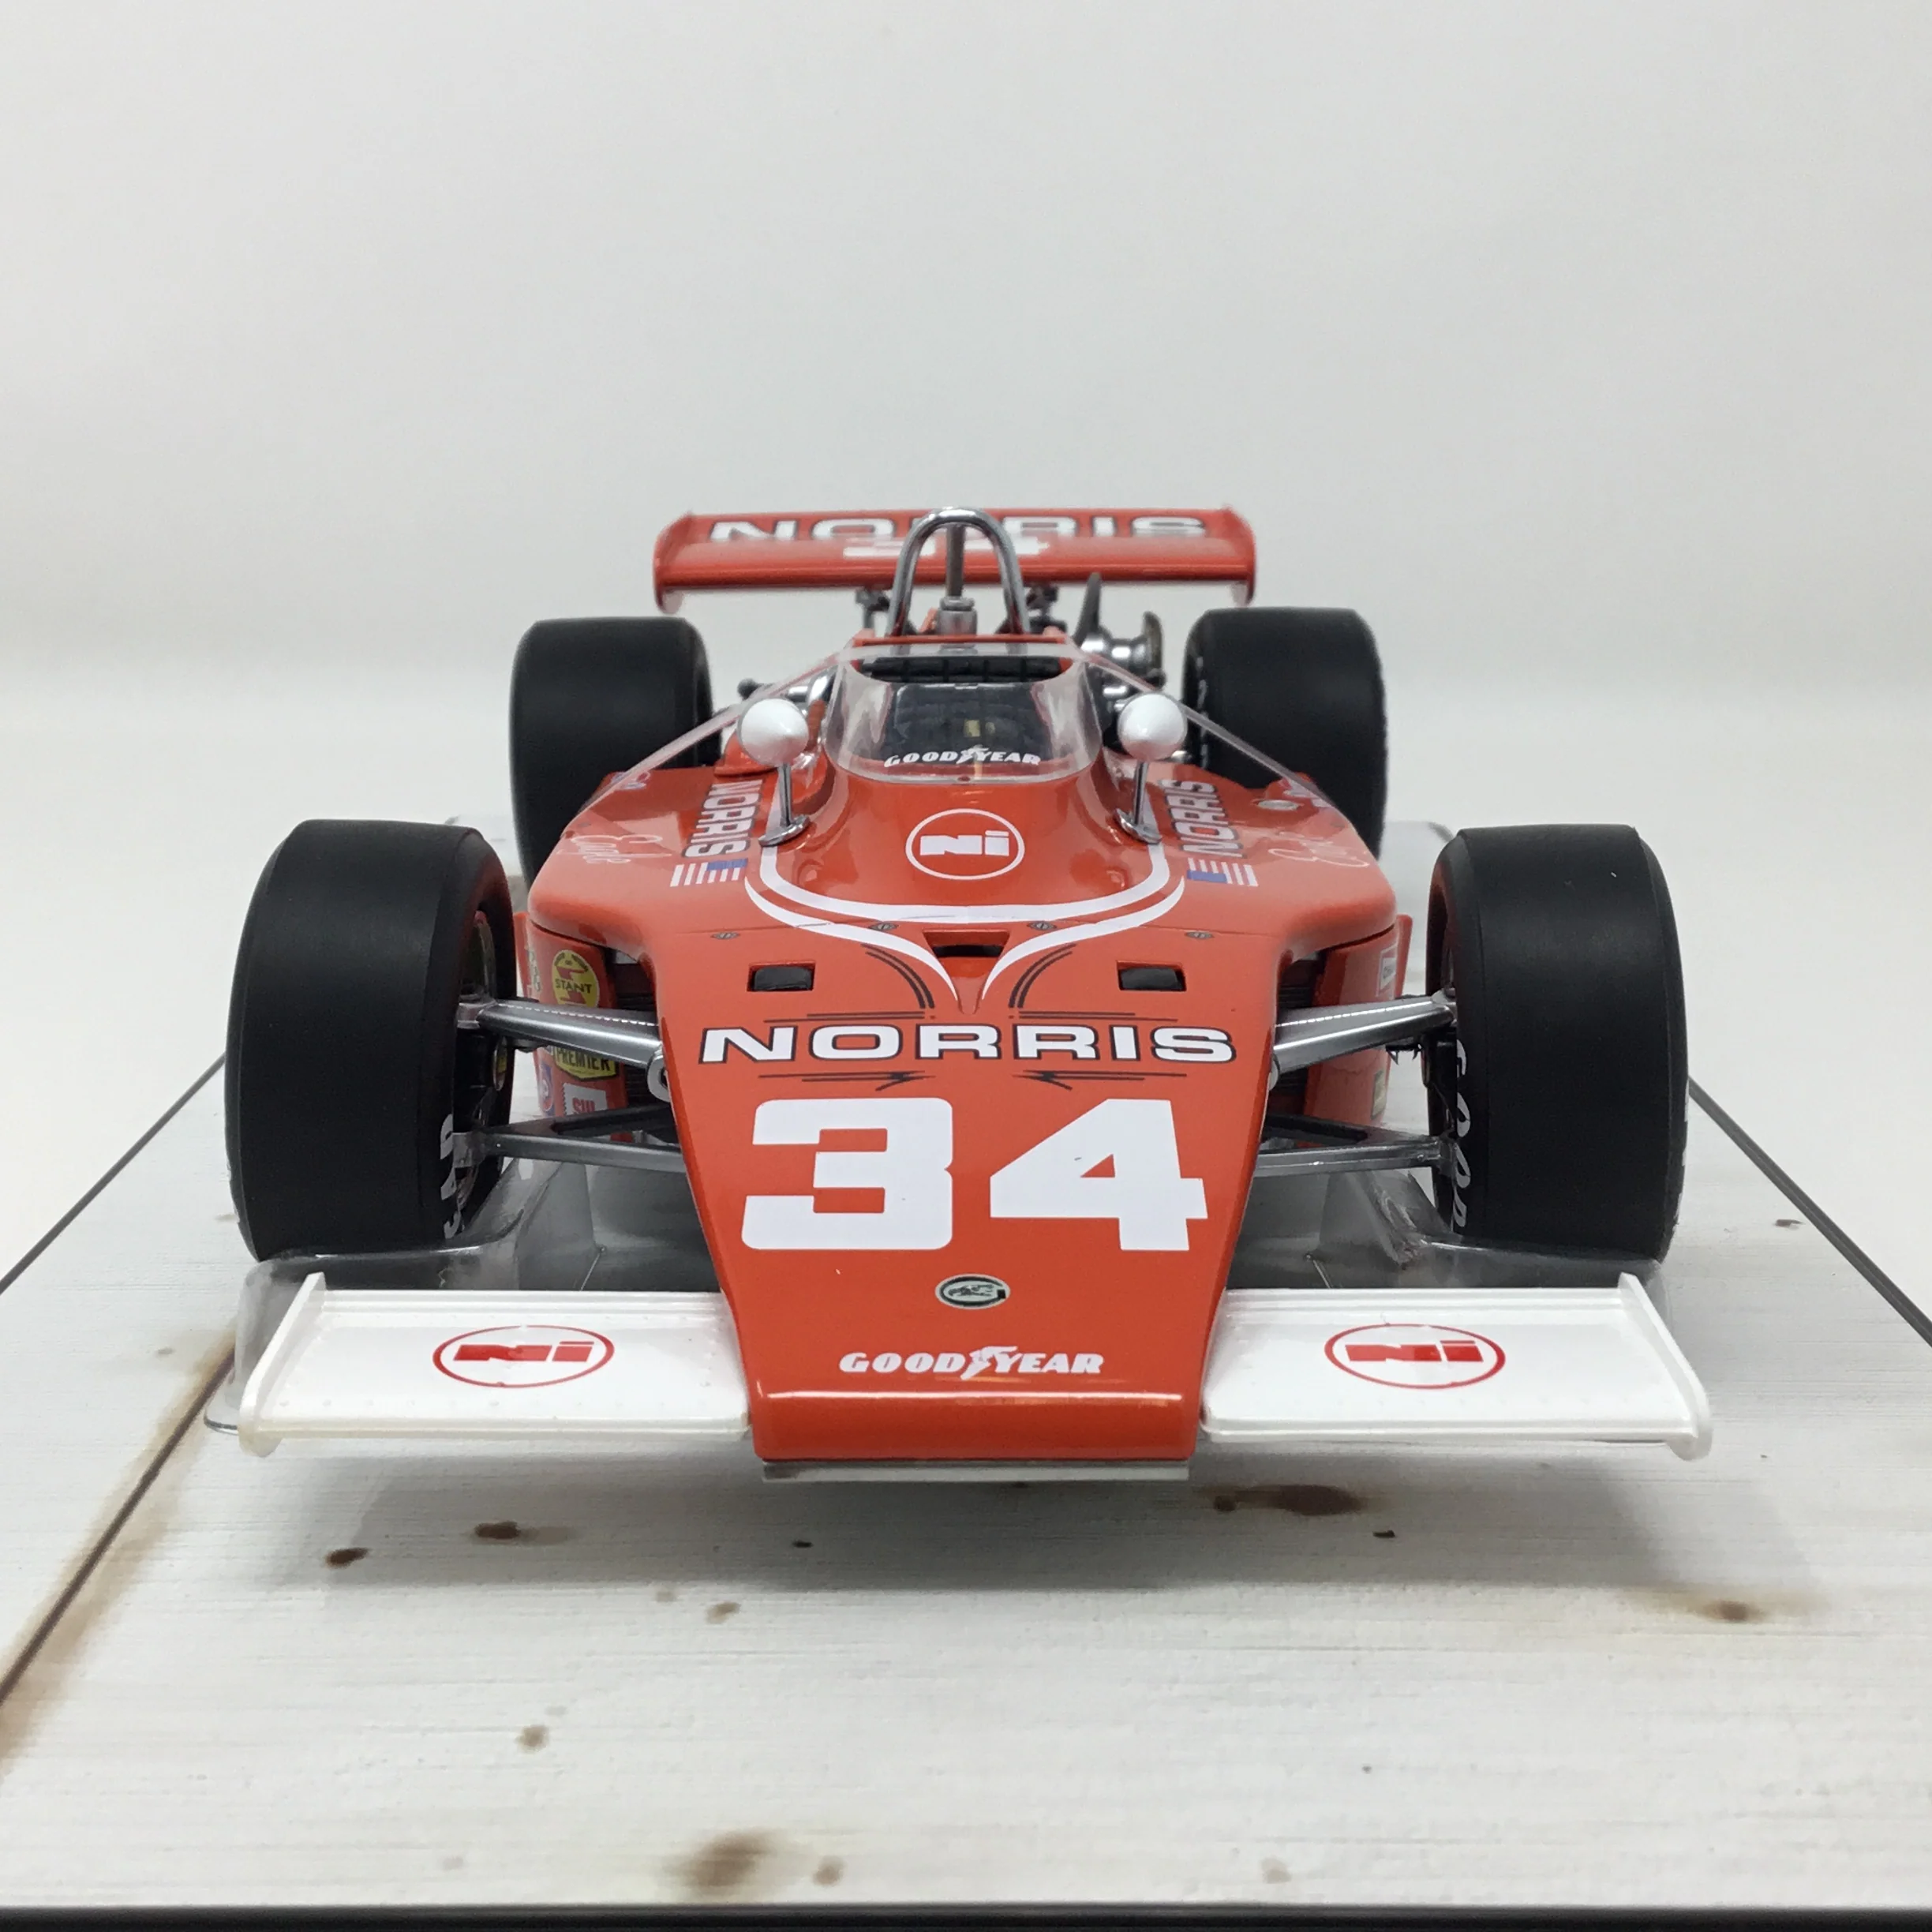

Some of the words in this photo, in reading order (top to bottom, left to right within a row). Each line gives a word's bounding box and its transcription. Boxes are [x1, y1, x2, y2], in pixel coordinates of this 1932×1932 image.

[710, 515, 1206, 541] NORIS
[883, 745, 1042, 767] GOODYEAR
[682, 778, 764, 859] NORRIS
[1159, 778, 1247, 859] NORRIS
[555, 979, 593, 994] STANT
[698, 1024, 1236, 1064] NORRIS
[742, 1098, 1208, 1251] 34
[839, 1346, 1104, 1381] GOODYEAR
